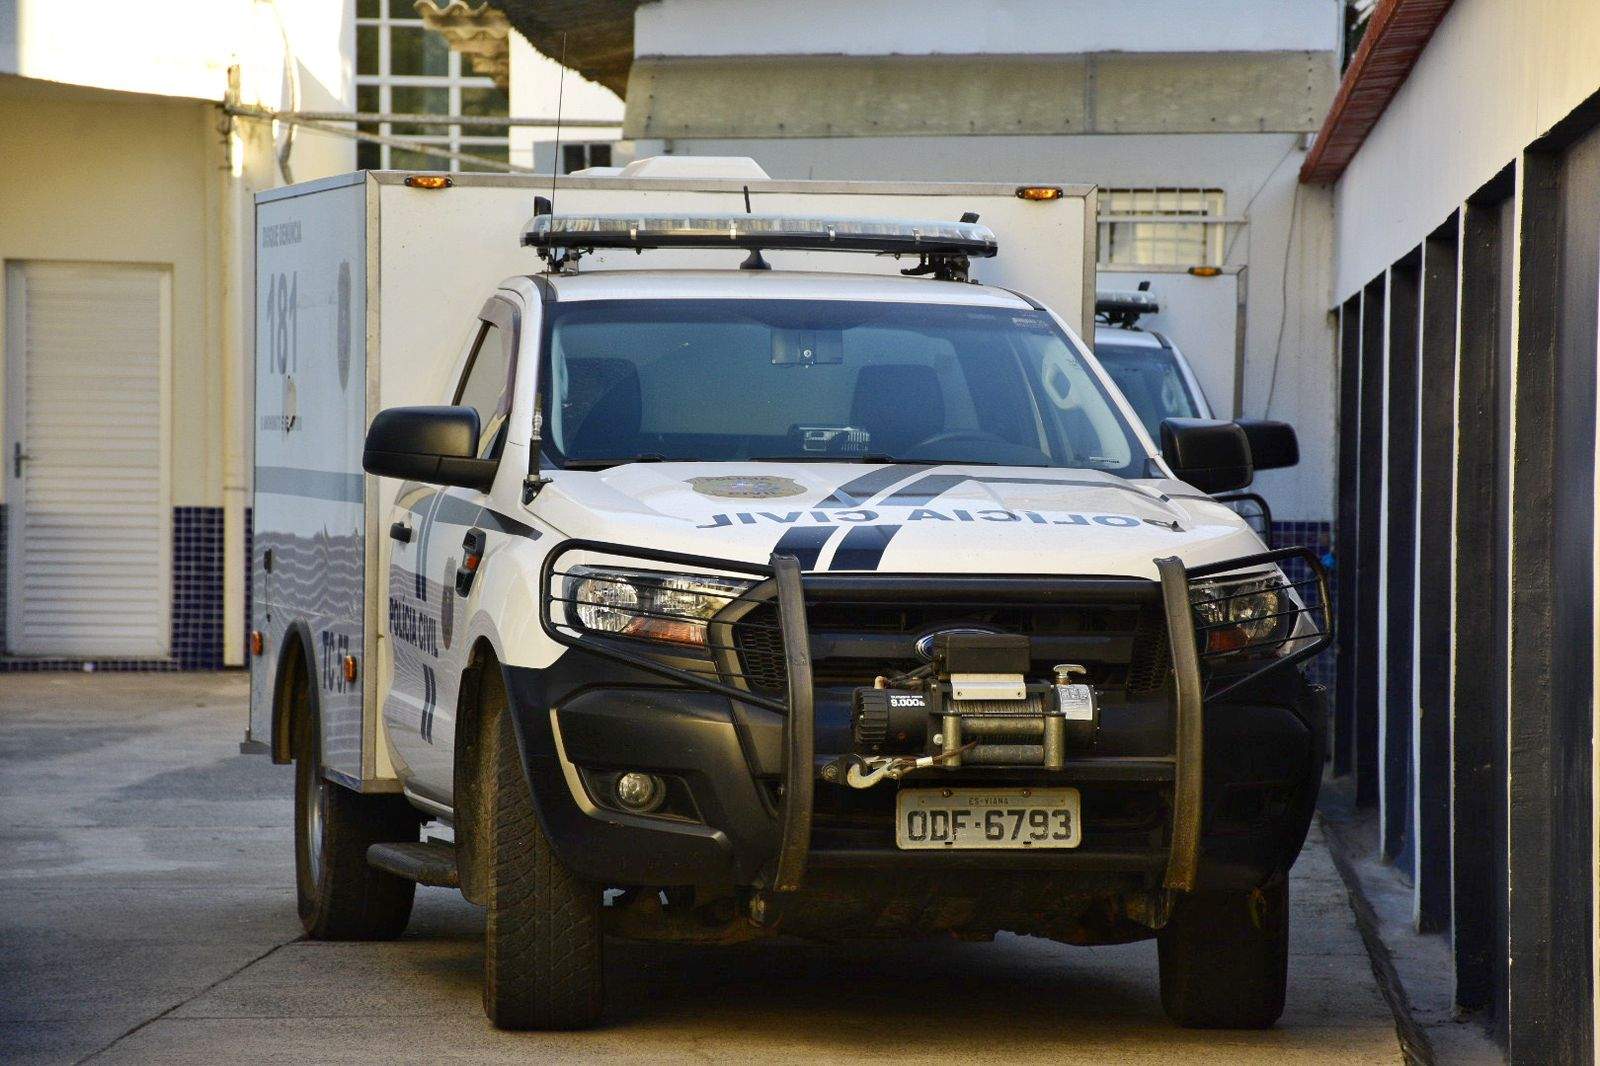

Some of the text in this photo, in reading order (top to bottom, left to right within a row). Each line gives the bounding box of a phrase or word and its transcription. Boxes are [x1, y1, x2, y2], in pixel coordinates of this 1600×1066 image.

[266, 271, 298, 375] 181
[389, 593, 438, 658] POLÍCIA CIVIL
[322, 630, 335, 692] TC
